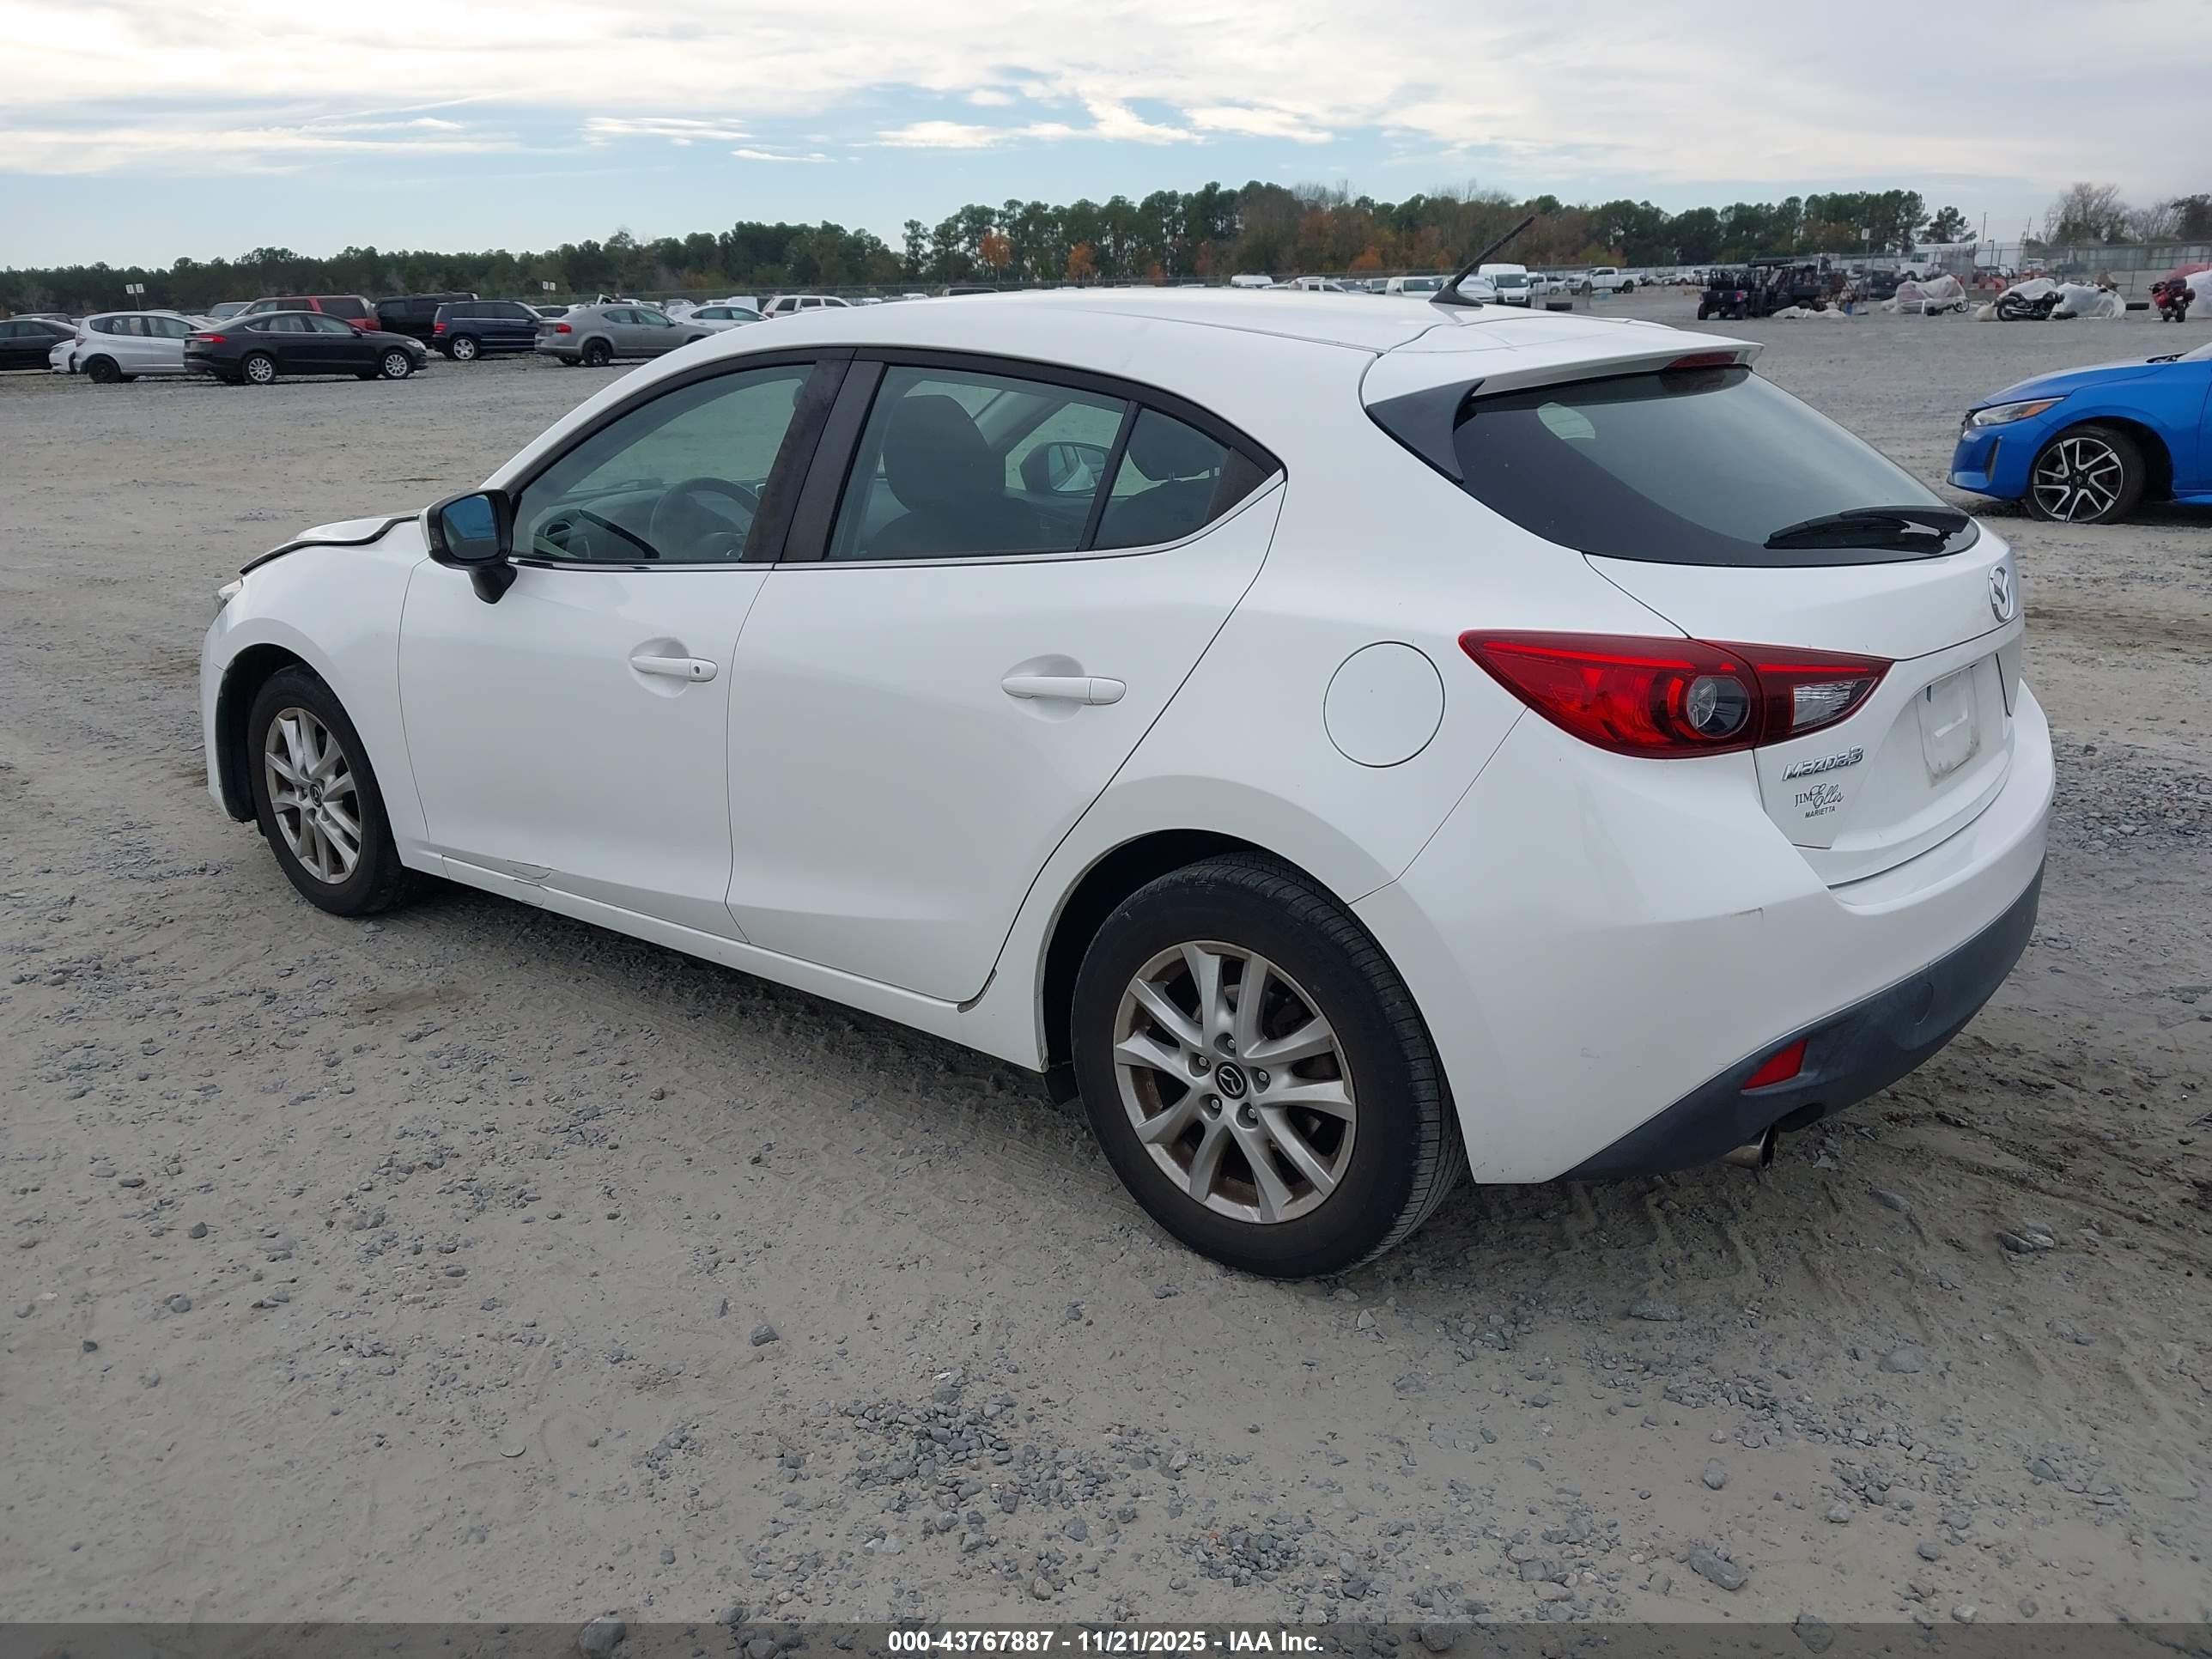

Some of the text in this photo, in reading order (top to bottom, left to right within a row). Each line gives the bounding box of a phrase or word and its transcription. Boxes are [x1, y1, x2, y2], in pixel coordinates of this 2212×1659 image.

[1794, 783, 1844, 809] JIM Ellis
[1804, 805, 1836, 818] MARIETTA
